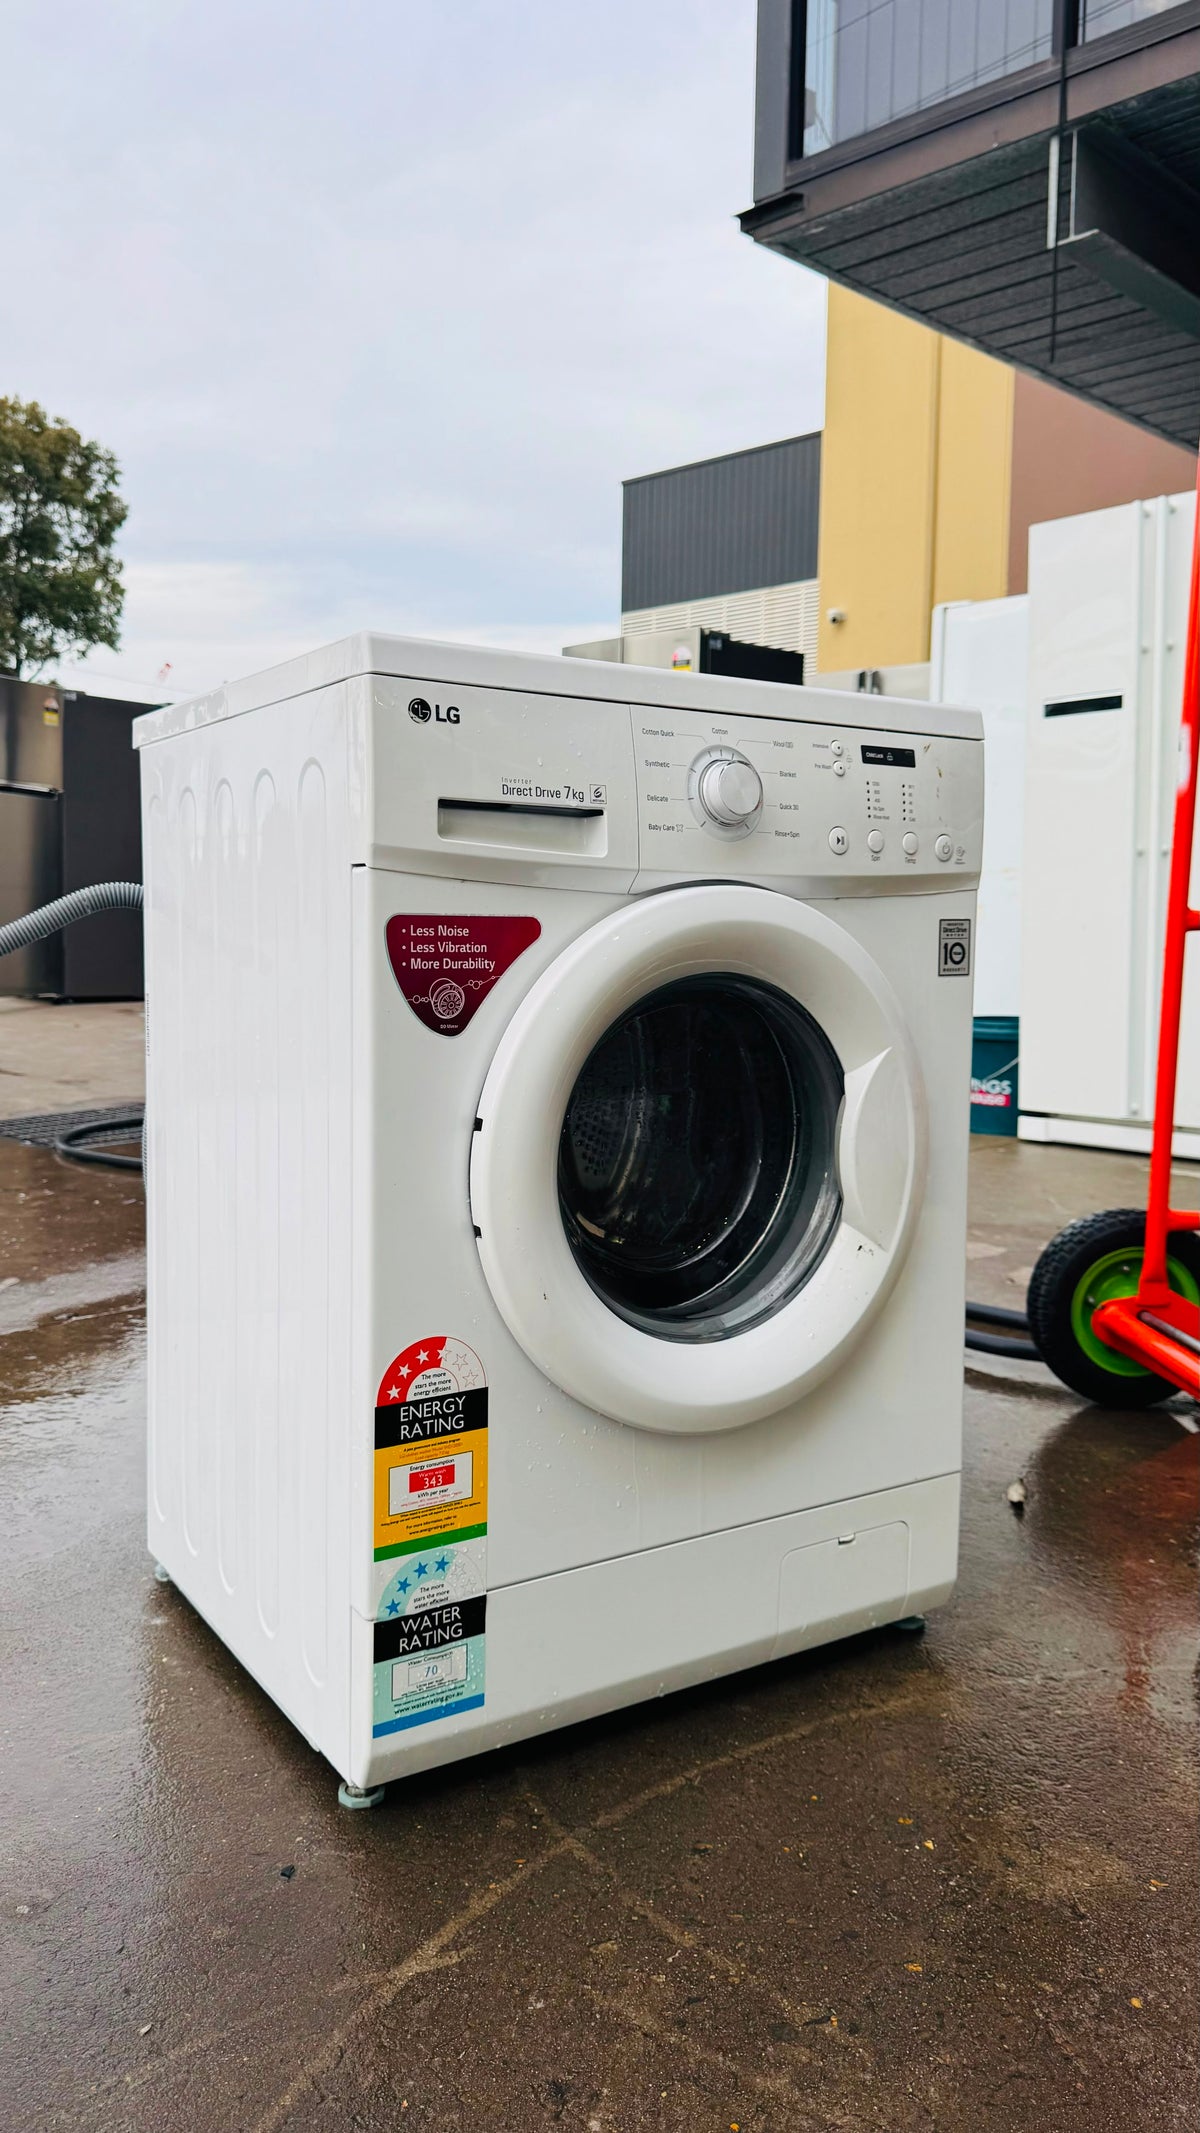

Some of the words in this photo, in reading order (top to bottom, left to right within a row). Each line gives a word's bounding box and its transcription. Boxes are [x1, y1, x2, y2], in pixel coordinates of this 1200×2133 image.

[435, 704, 460, 724] LG
[642, 728, 659, 736] Cotton
[645, 760, 670, 768] Synthetic
[501, 776, 532, 785] Inverter
[502, 784, 533, 797] Direct
[535, 786, 561, 799] Drive
[647, 794, 669, 802] Delicate
[648, 823, 662, 832] Baby
[410, 924, 435, 936] Less
[438, 924, 470, 937] Noise
[410, 941, 435, 953] Less
[438, 941, 487, 953] Vibration
[410, 957, 440, 970] More
[443, 957, 496, 973] Durability
[432, 1386, 451, 1394] efficient
[400, 1395, 466, 1422] ENERGY
[400, 1414, 465, 1440] RATING
[409, 1464, 425, 1472] Energy
[426, 1458, 455, 1469] consumption
[423, 1475, 443, 1489] 343
[401, 1606, 461, 1634] WATER
[399, 1622, 463, 1653] RATING
[425, 1664, 438, 1678] 70
